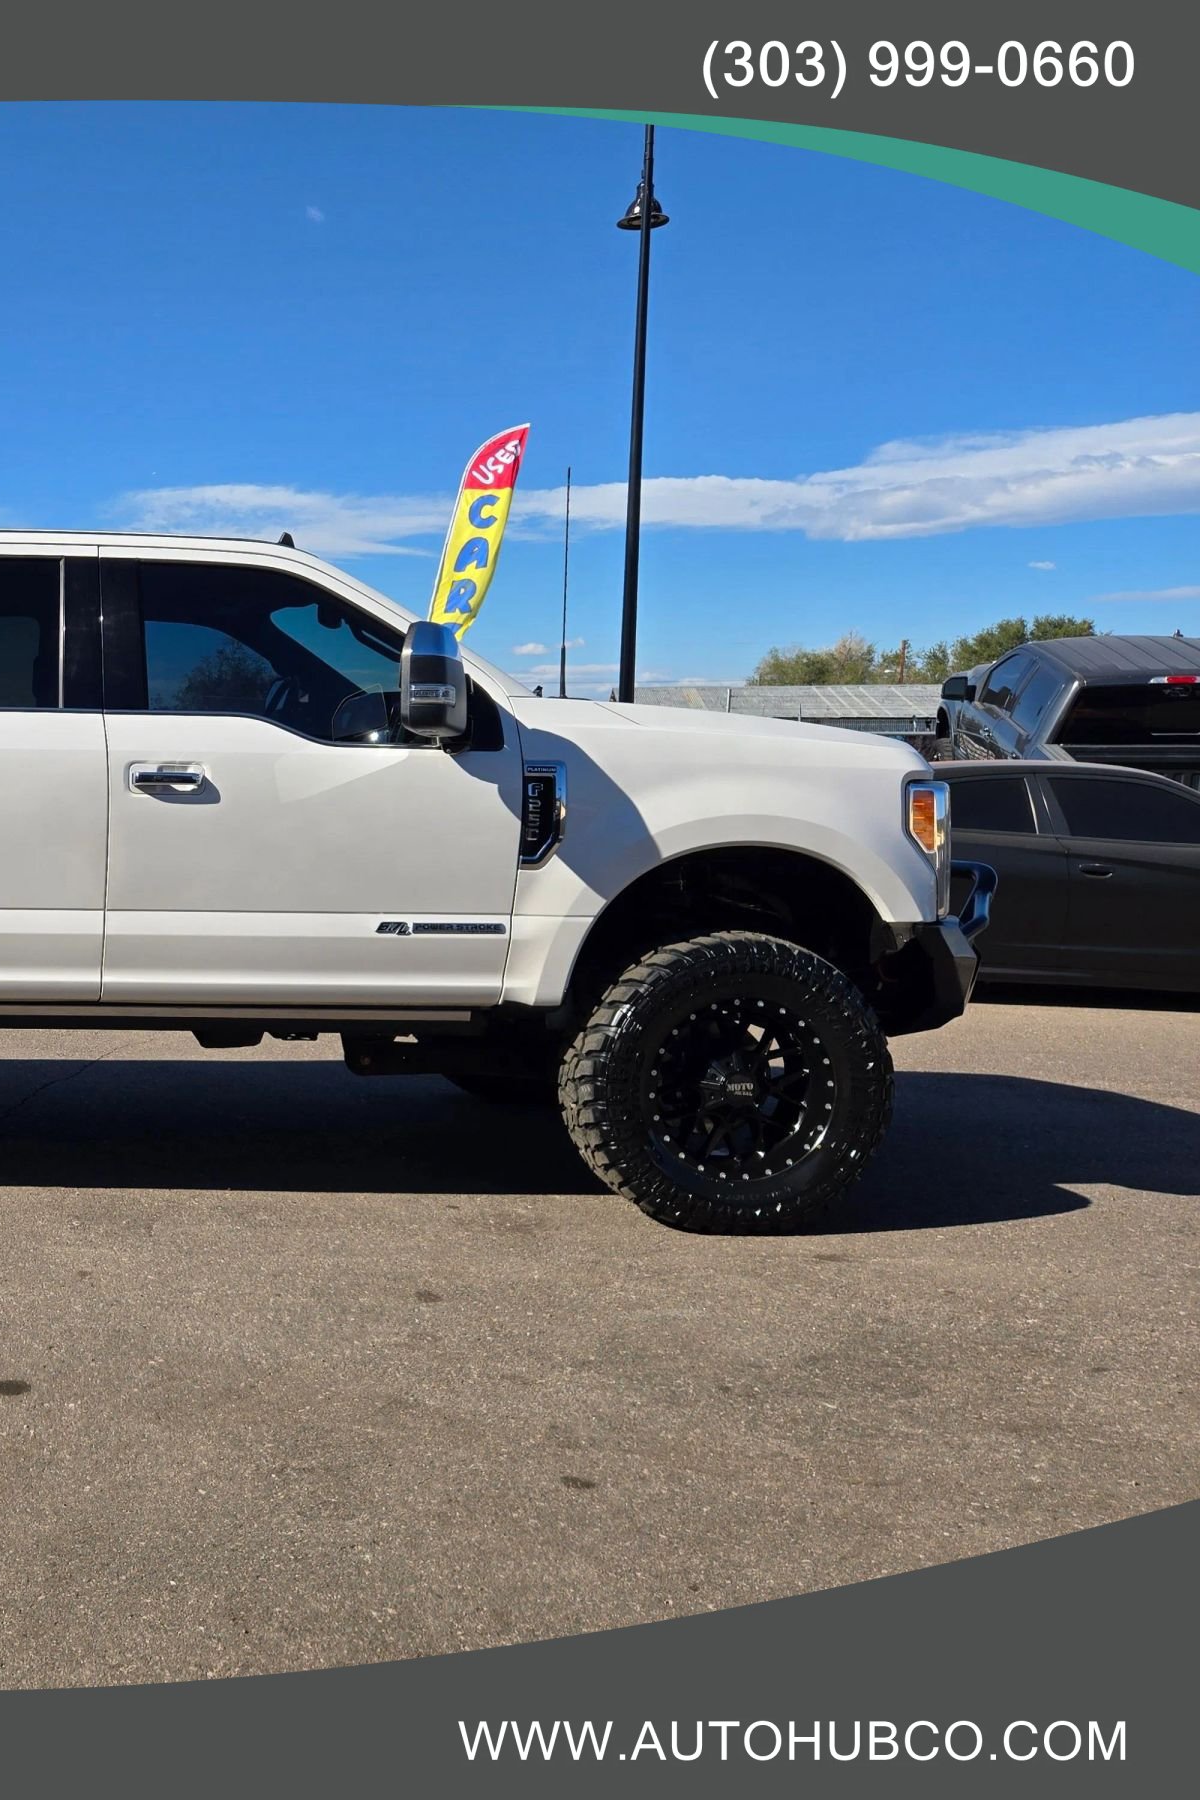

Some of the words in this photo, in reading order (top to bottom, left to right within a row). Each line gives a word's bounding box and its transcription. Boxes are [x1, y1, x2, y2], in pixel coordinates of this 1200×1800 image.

[441, 494, 500, 634] CAR
[413, 923, 455, 931] POWER
[459, 923, 500, 931] STROKE
[726, 1081, 754, 1092] MOTO
